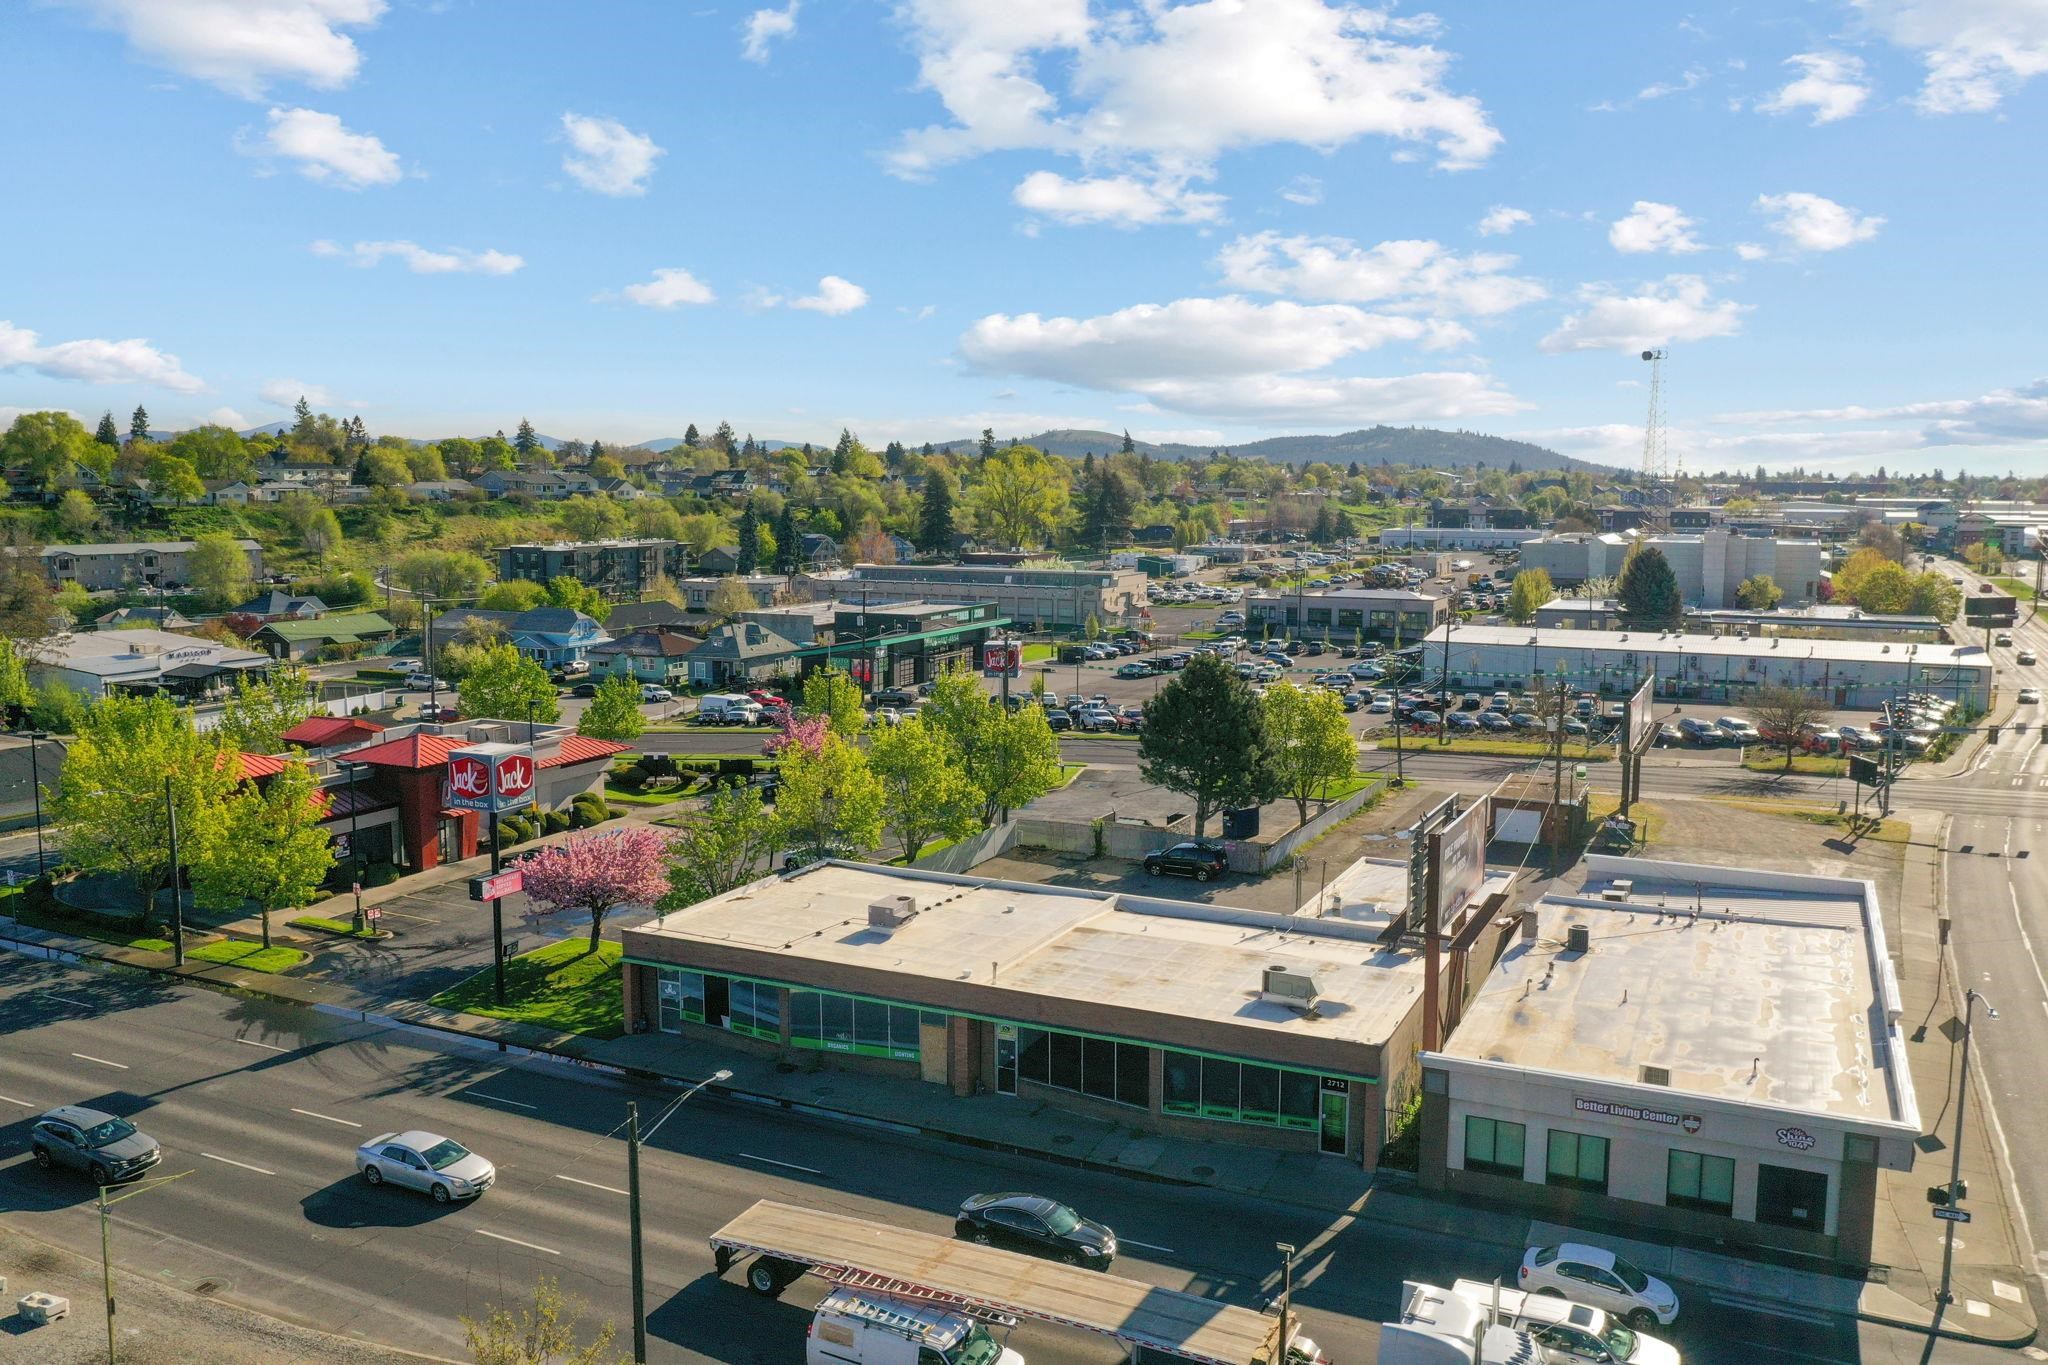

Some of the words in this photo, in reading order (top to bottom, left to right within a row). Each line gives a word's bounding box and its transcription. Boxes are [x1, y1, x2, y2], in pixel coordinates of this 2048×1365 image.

[451, 762, 488, 794] Jack
[498, 759, 532, 793] Jack
[453, 798, 461, 806] in
[461, 799, 474, 807] the
[474, 800, 488, 808] box
[1327, 1079, 1345, 1089] 2712
[1576, 1100, 1608, 1113] Better
[1610, 1105, 1640, 1119] Living
[1642, 1109, 1679, 1124] Center
[1777, 1129, 1815, 1144] Shine
